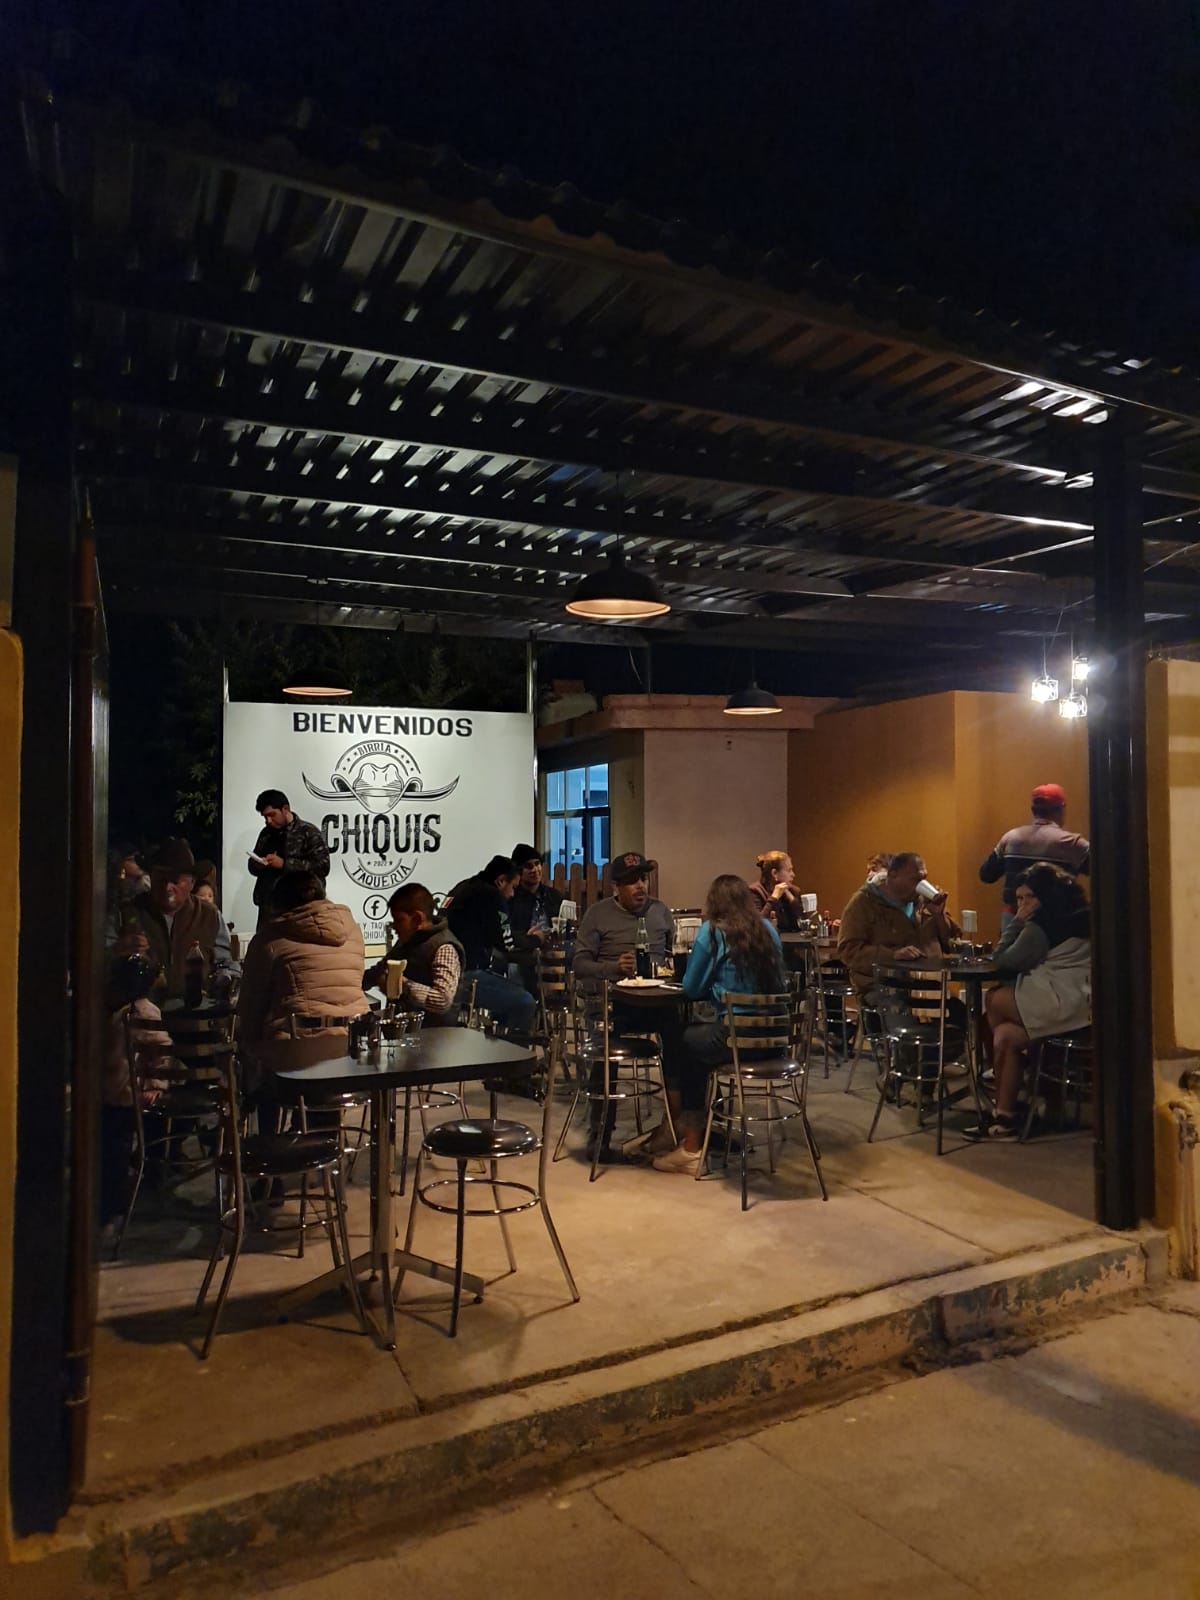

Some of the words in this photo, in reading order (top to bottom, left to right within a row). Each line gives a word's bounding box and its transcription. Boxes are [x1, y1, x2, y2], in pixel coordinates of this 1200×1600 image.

[293, 712, 473, 737] BIENVENIDOS
[357, 742, 391, 755] BIRRIA
[321, 813, 442, 860] CHIQUIS
[352, 865, 411, 888] TAQUERIA
